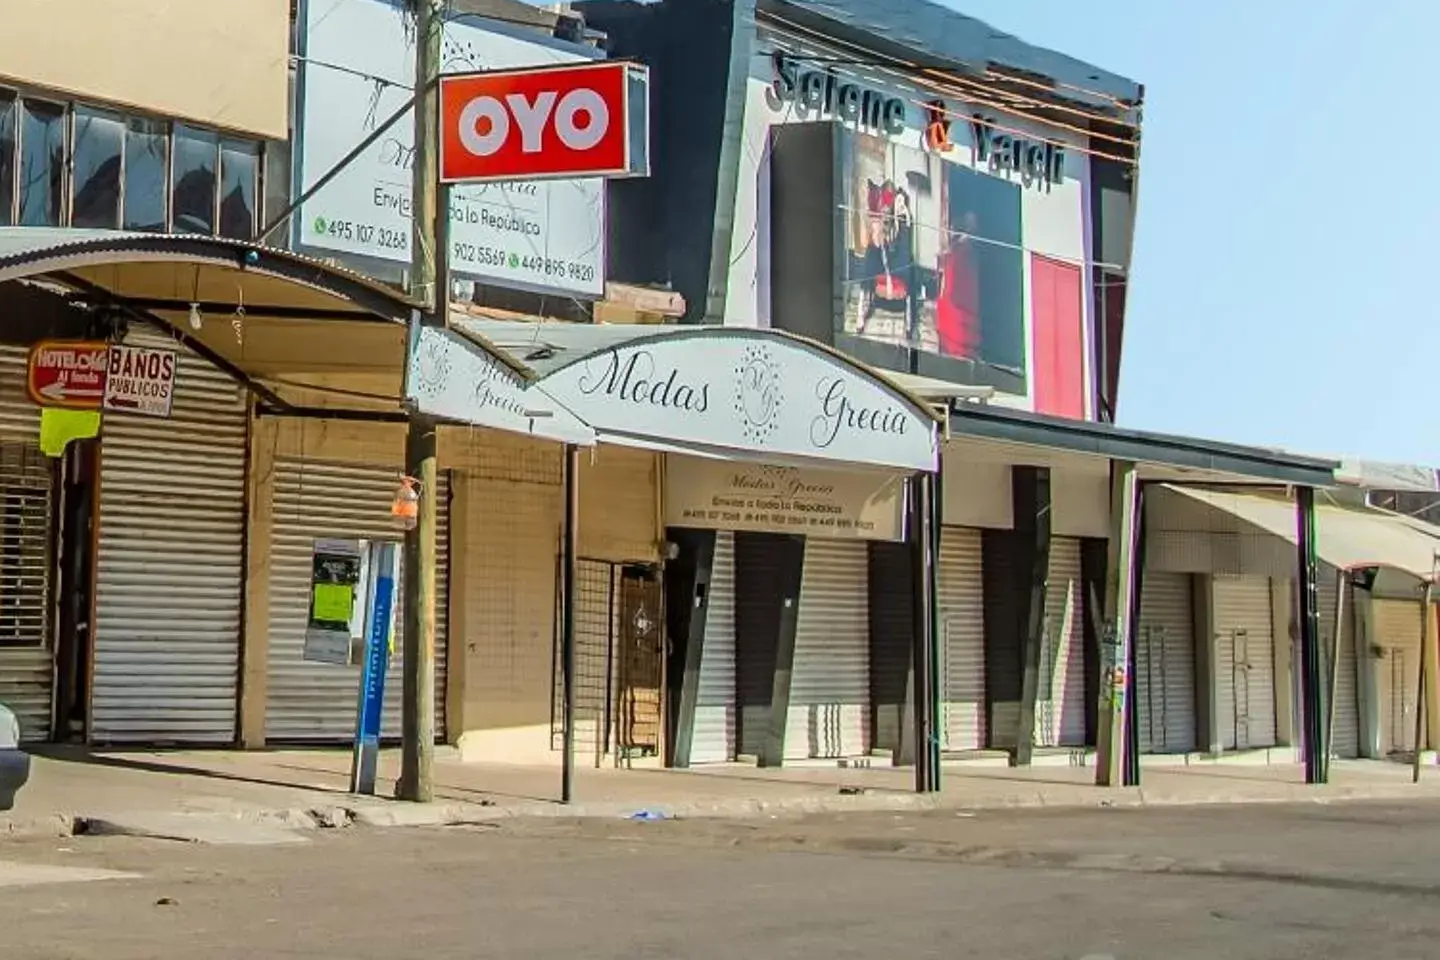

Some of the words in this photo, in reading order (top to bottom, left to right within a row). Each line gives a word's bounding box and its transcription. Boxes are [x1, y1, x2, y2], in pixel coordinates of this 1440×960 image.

[458, 86, 610, 158] OYO
[328, 220, 353, 240] 495
[356, 224, 374, 243] 107
[453, 242, 475, 263] 902
[521, 254, 543, 274] 449
[578, 348, 711, 414] Modas
[809, 376, 908, 449] Grecia
